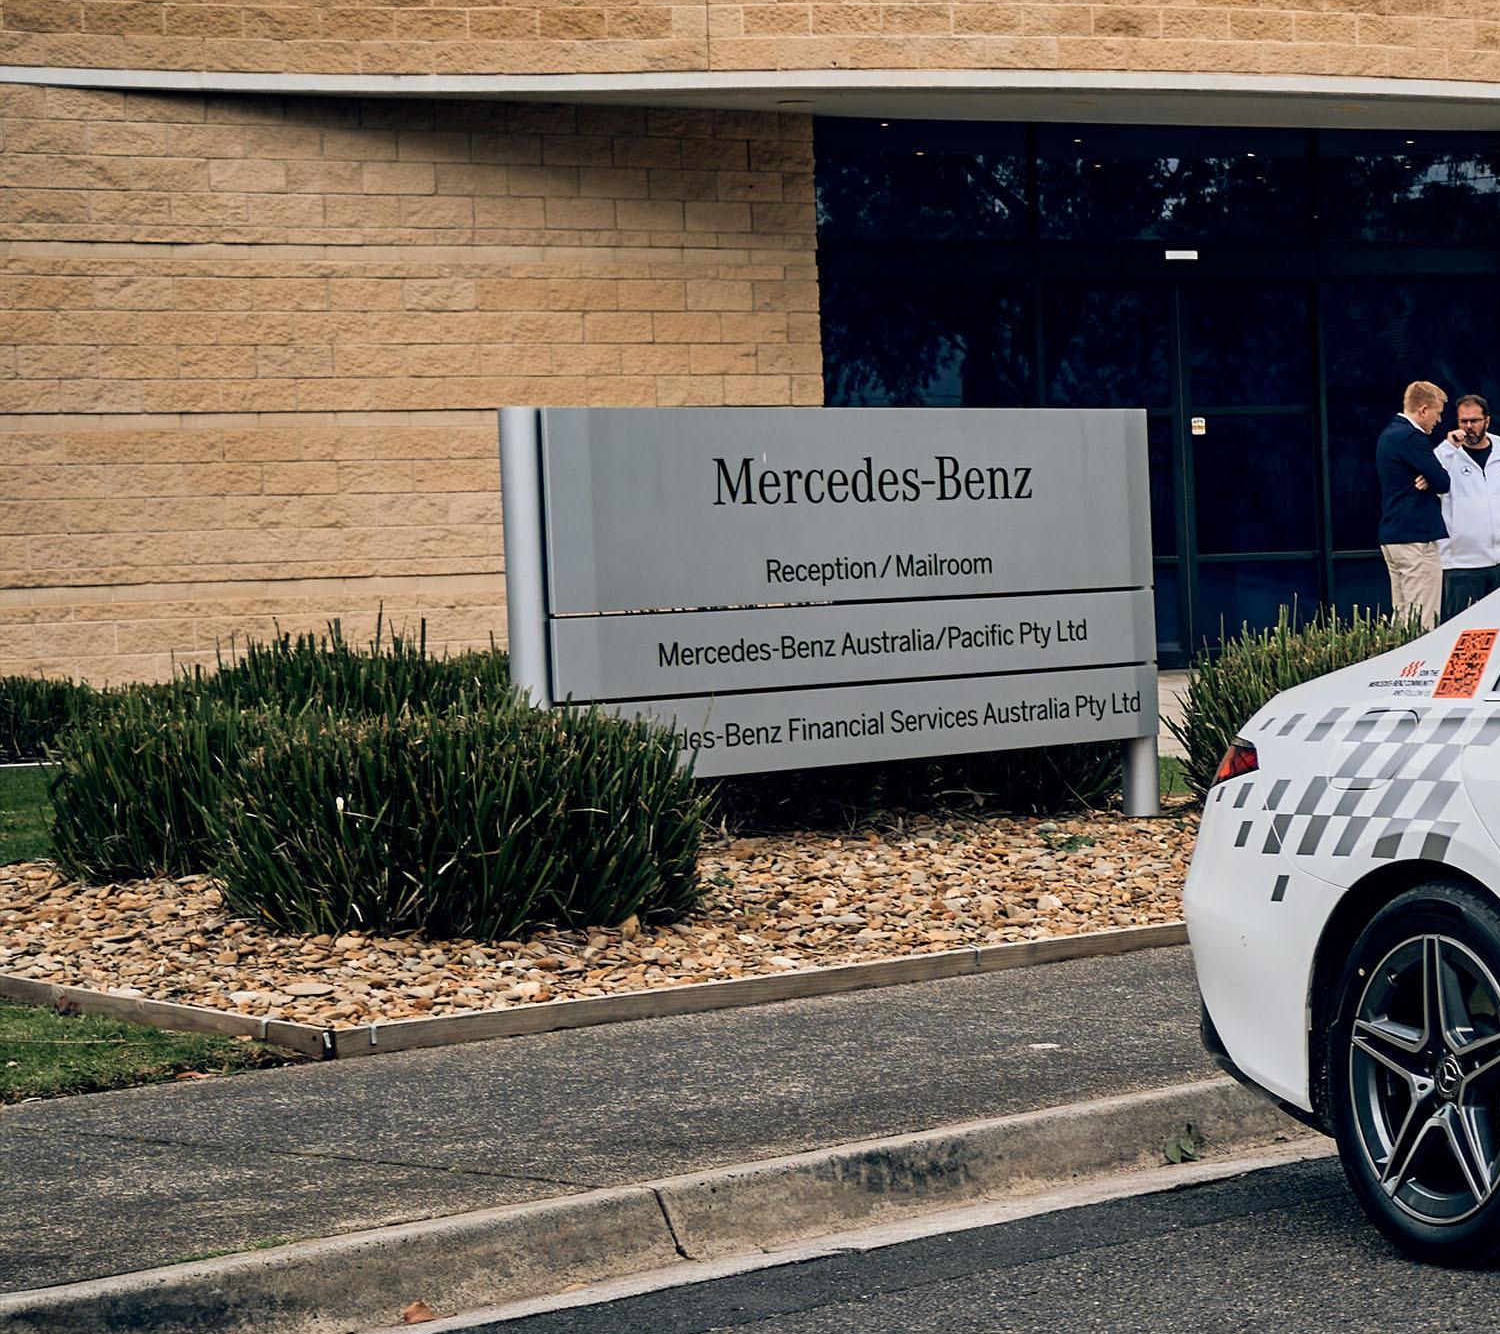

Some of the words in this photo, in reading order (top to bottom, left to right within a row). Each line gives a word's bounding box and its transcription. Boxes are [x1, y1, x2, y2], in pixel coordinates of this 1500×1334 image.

[712, 456, 1033, 506] Mercedes-Benz
[766, 556, 877, 587] Reception
[895, 552, 993, 578] Mailroom
[658, 635, 837, 668] Mercedes-Benz
[841, 623, 1014, 657] Australia/Pacific
[1019, 621, 1052, 650] Pty
[1056, 618, 1088, 642] Ltd
[677, 721, 783, 750] des-Benz
[788, 711, 885, 742] Financial
[890, 706, 979, 734] Services
[982, 697, 1070, 727] Australia
[1075, 694, 1107, 723] Pty
[1111, 690, 1142, 715] Ltd
